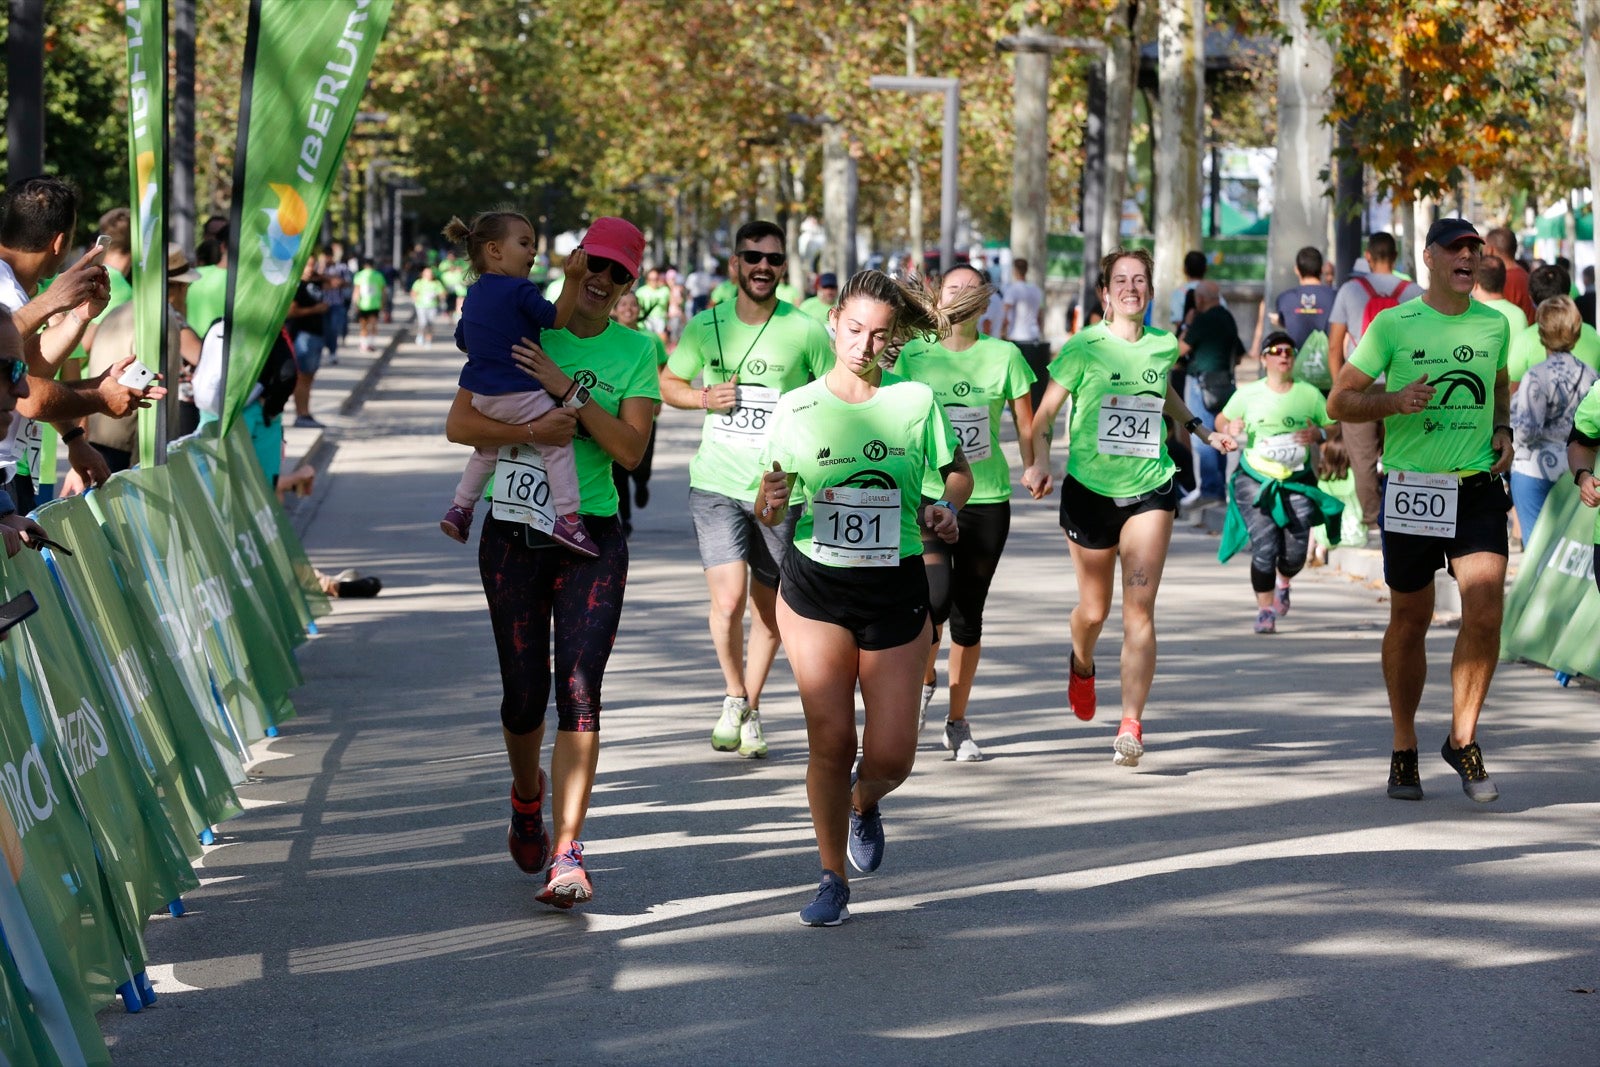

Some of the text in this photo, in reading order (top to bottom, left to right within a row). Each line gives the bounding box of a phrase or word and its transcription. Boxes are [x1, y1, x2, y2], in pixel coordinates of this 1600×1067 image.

[1106, 414, 1150, 440] 234
[818, 456, 857, 467] IBERDROLA
[506, 470, 550, 508] 180
[1395, 491, 1446, 518] 650
[828, 511, 881, 544] 181
